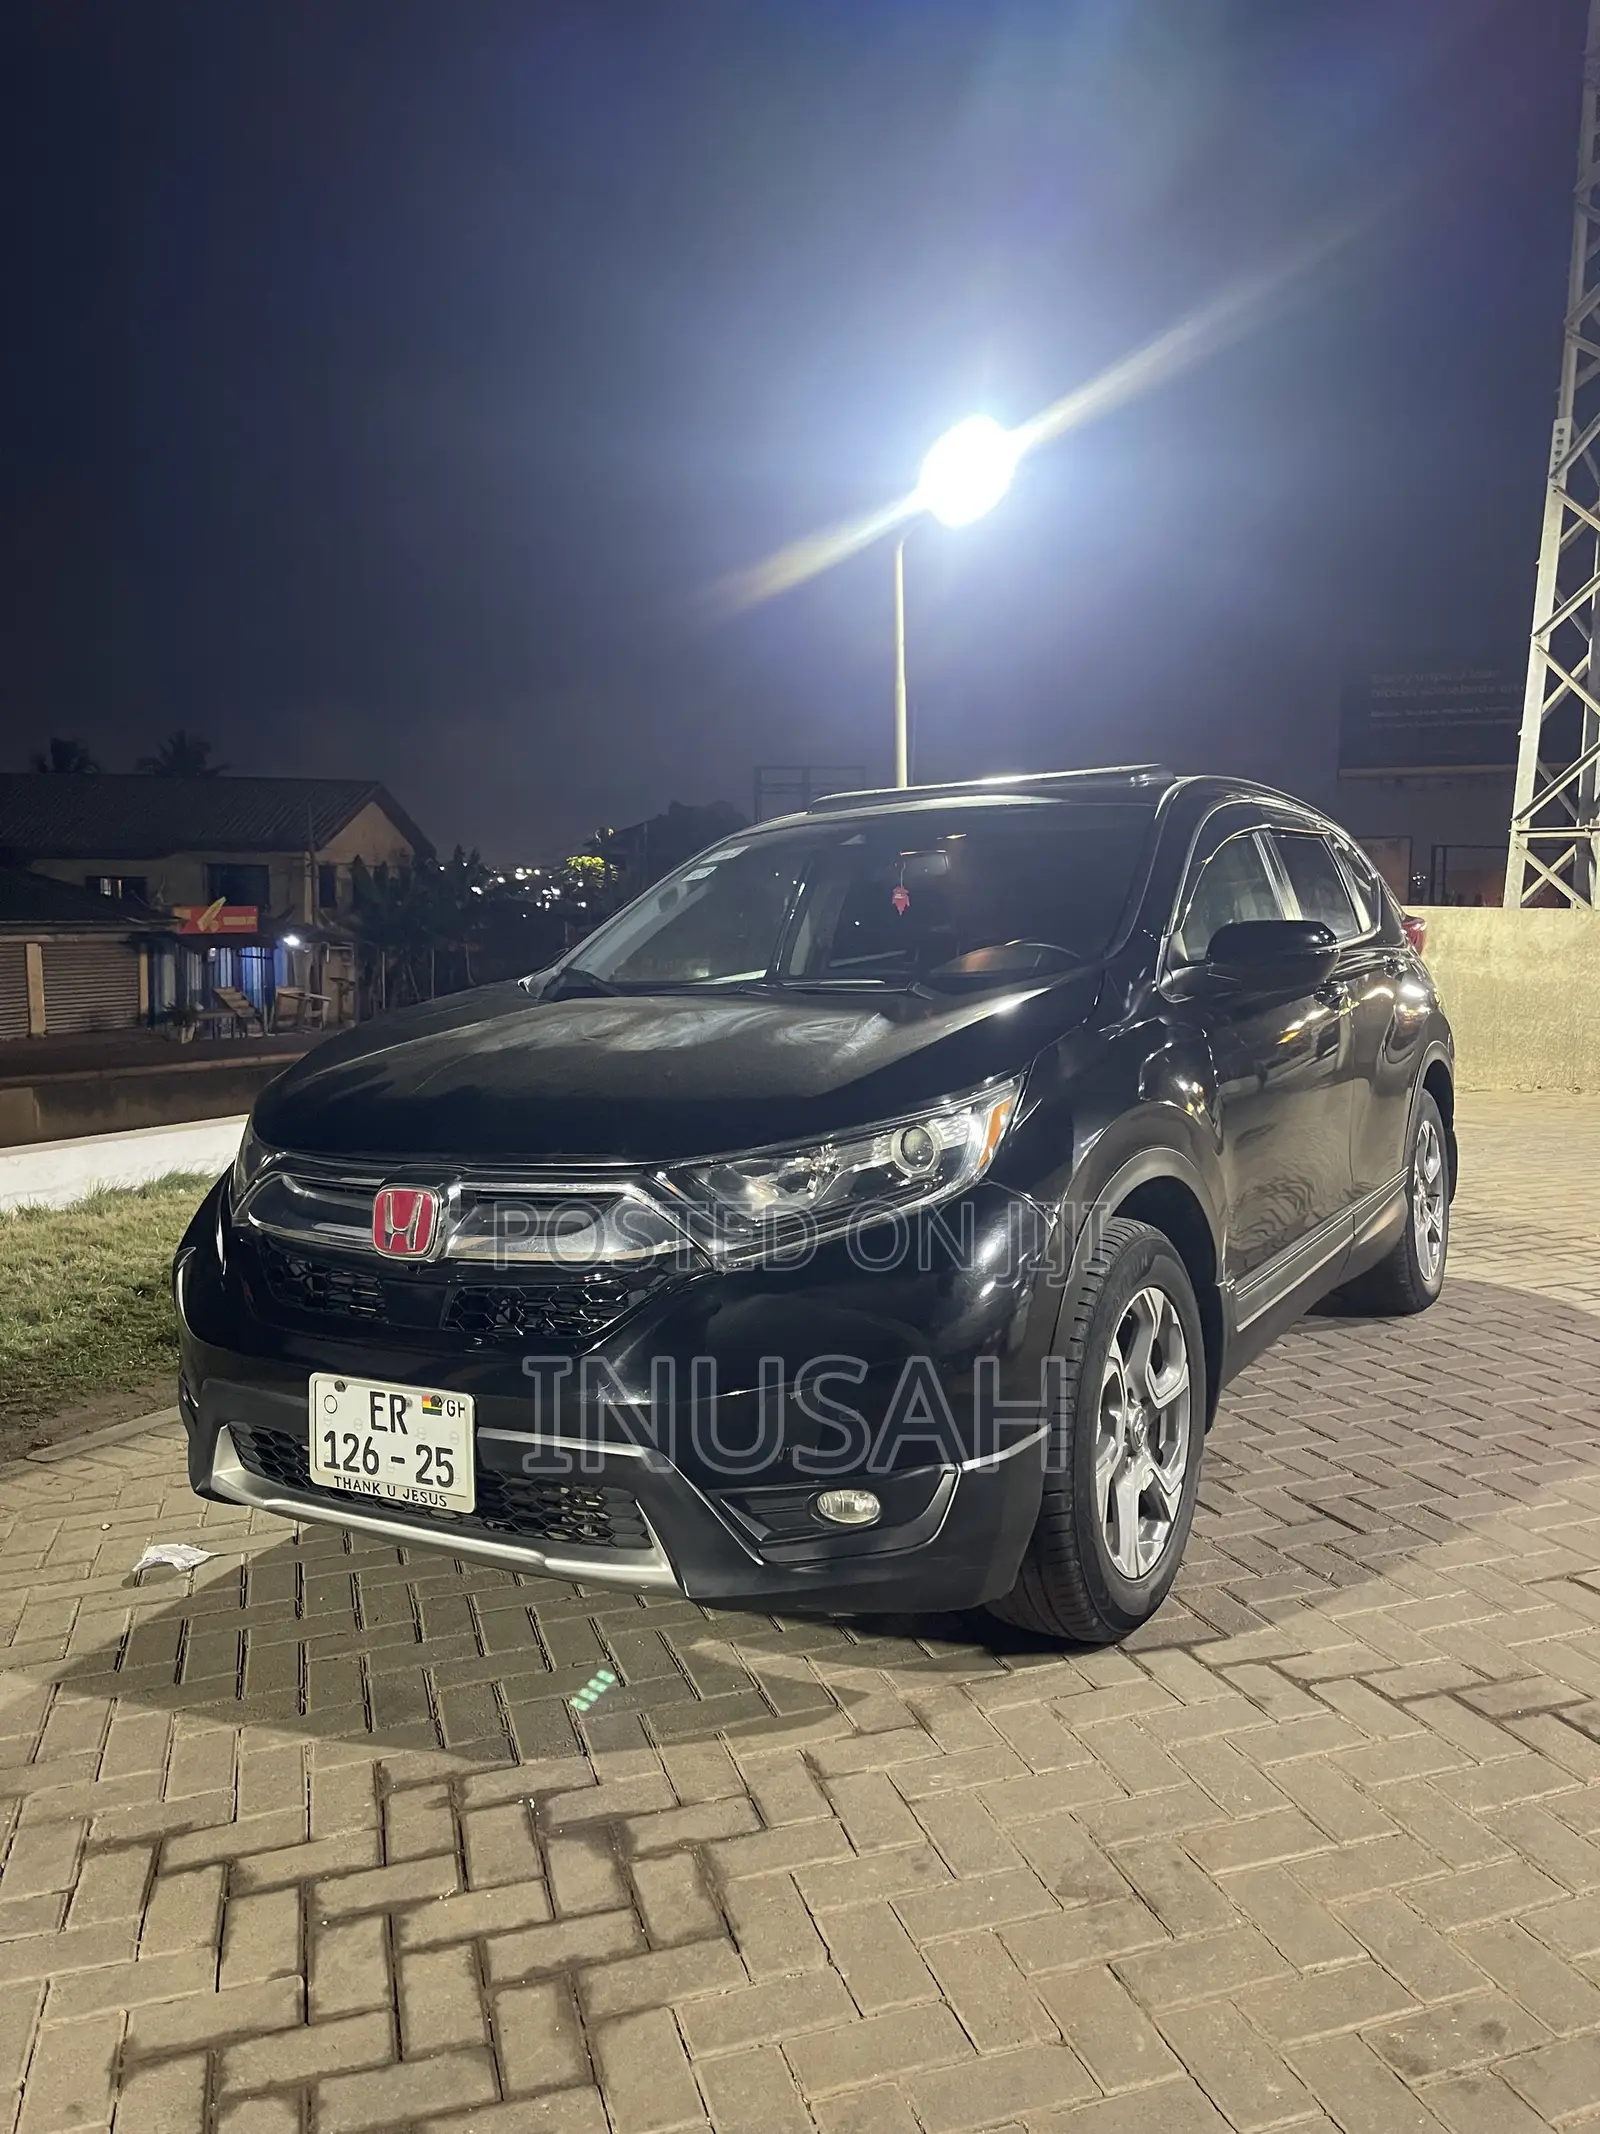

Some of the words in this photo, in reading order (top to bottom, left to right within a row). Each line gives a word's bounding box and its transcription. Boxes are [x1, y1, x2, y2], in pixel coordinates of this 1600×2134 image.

[369, 1391, 408, 1435] ER
[323, 1430, 380, 1475] 126
[415, 1444, 455, 1488] 25
[334, 1475, 381, 1495] THANK
[387, 1485, 396, 1497] U
[402, 1488, 448, 1507] JESUS
